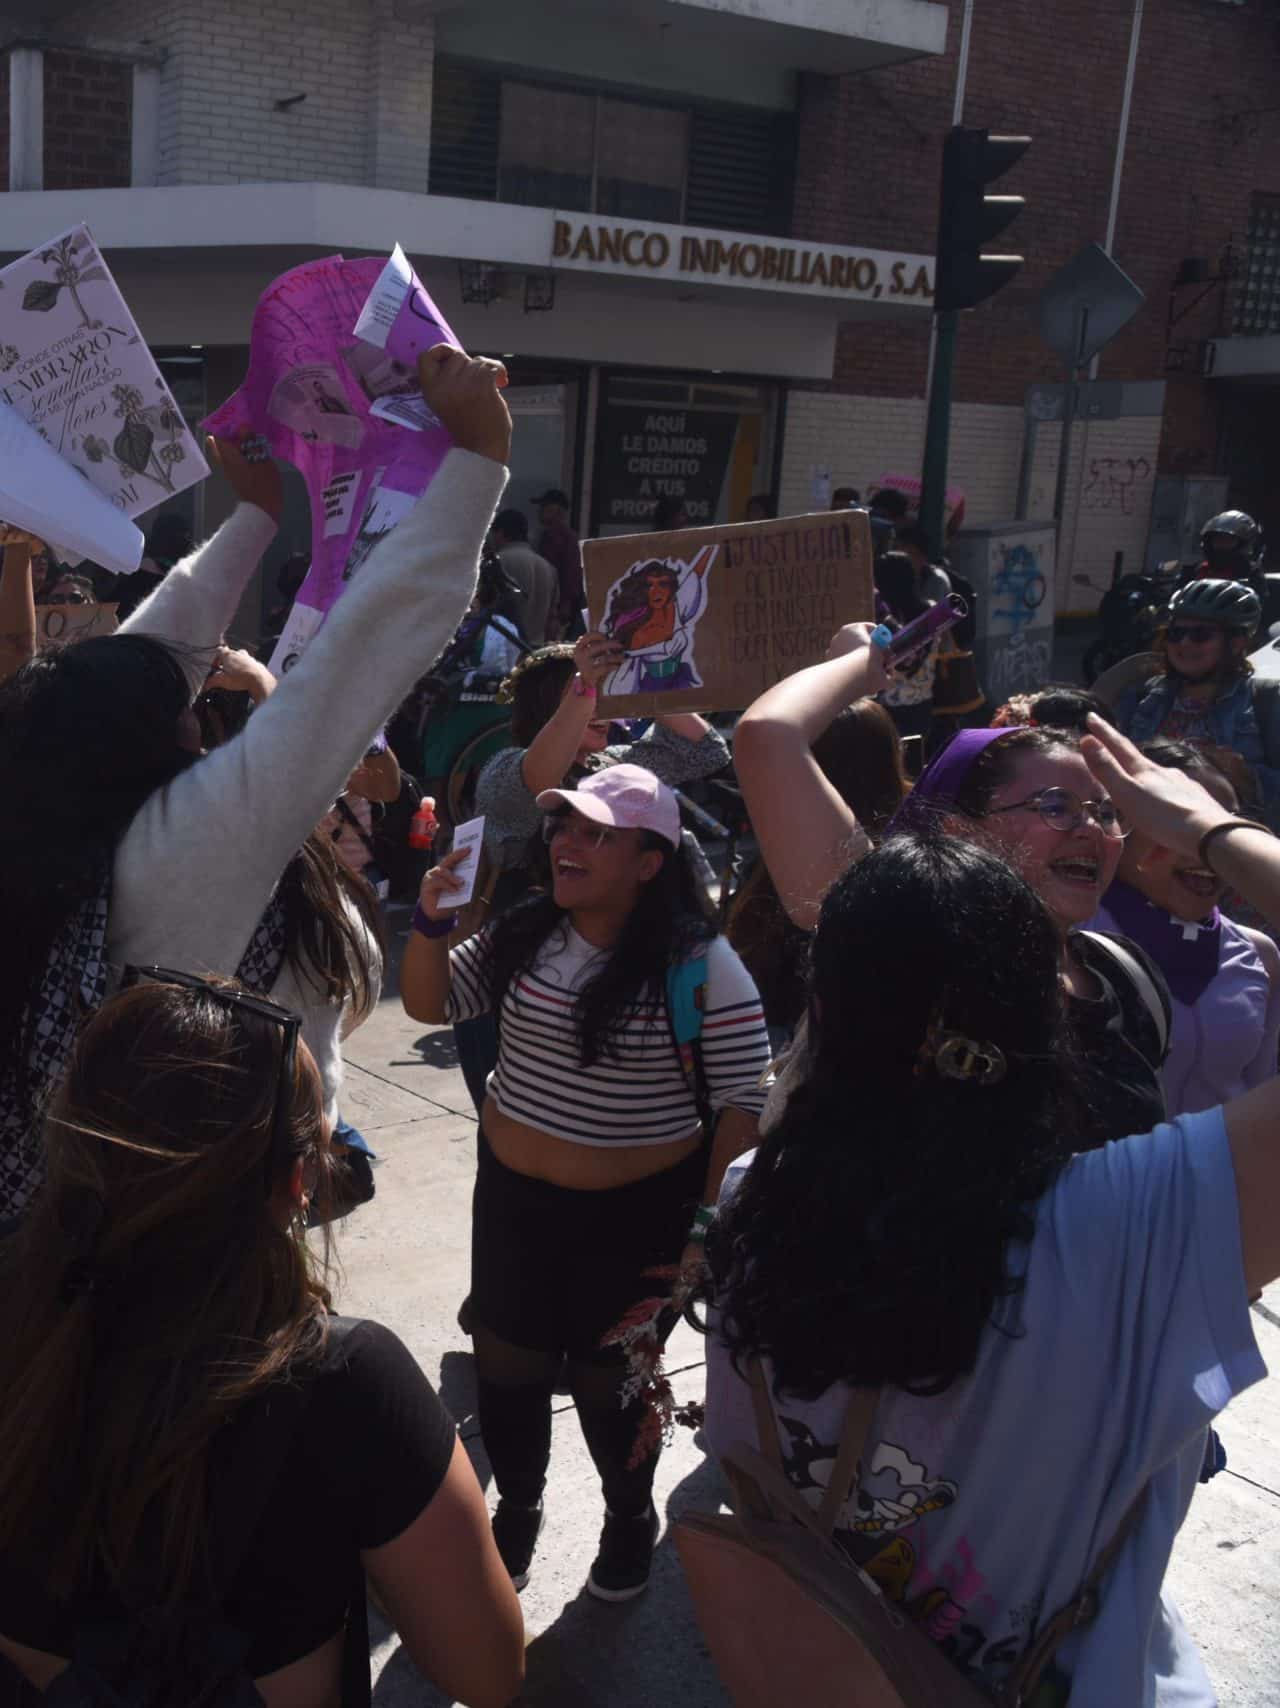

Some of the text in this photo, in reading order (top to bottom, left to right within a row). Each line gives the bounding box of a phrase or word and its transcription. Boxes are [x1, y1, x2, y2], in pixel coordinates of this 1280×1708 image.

[553, 220, 669, 269] BANCO
[679, 236, 882, 299] INMOBILIARIO,
[645, 412, 687, 433] AQUÍ
[622, 435, 707, 456] LE DAMOS
[628, 454, 699, 475] CRÉDITO
[640, 478, 686, 497] A TUS
